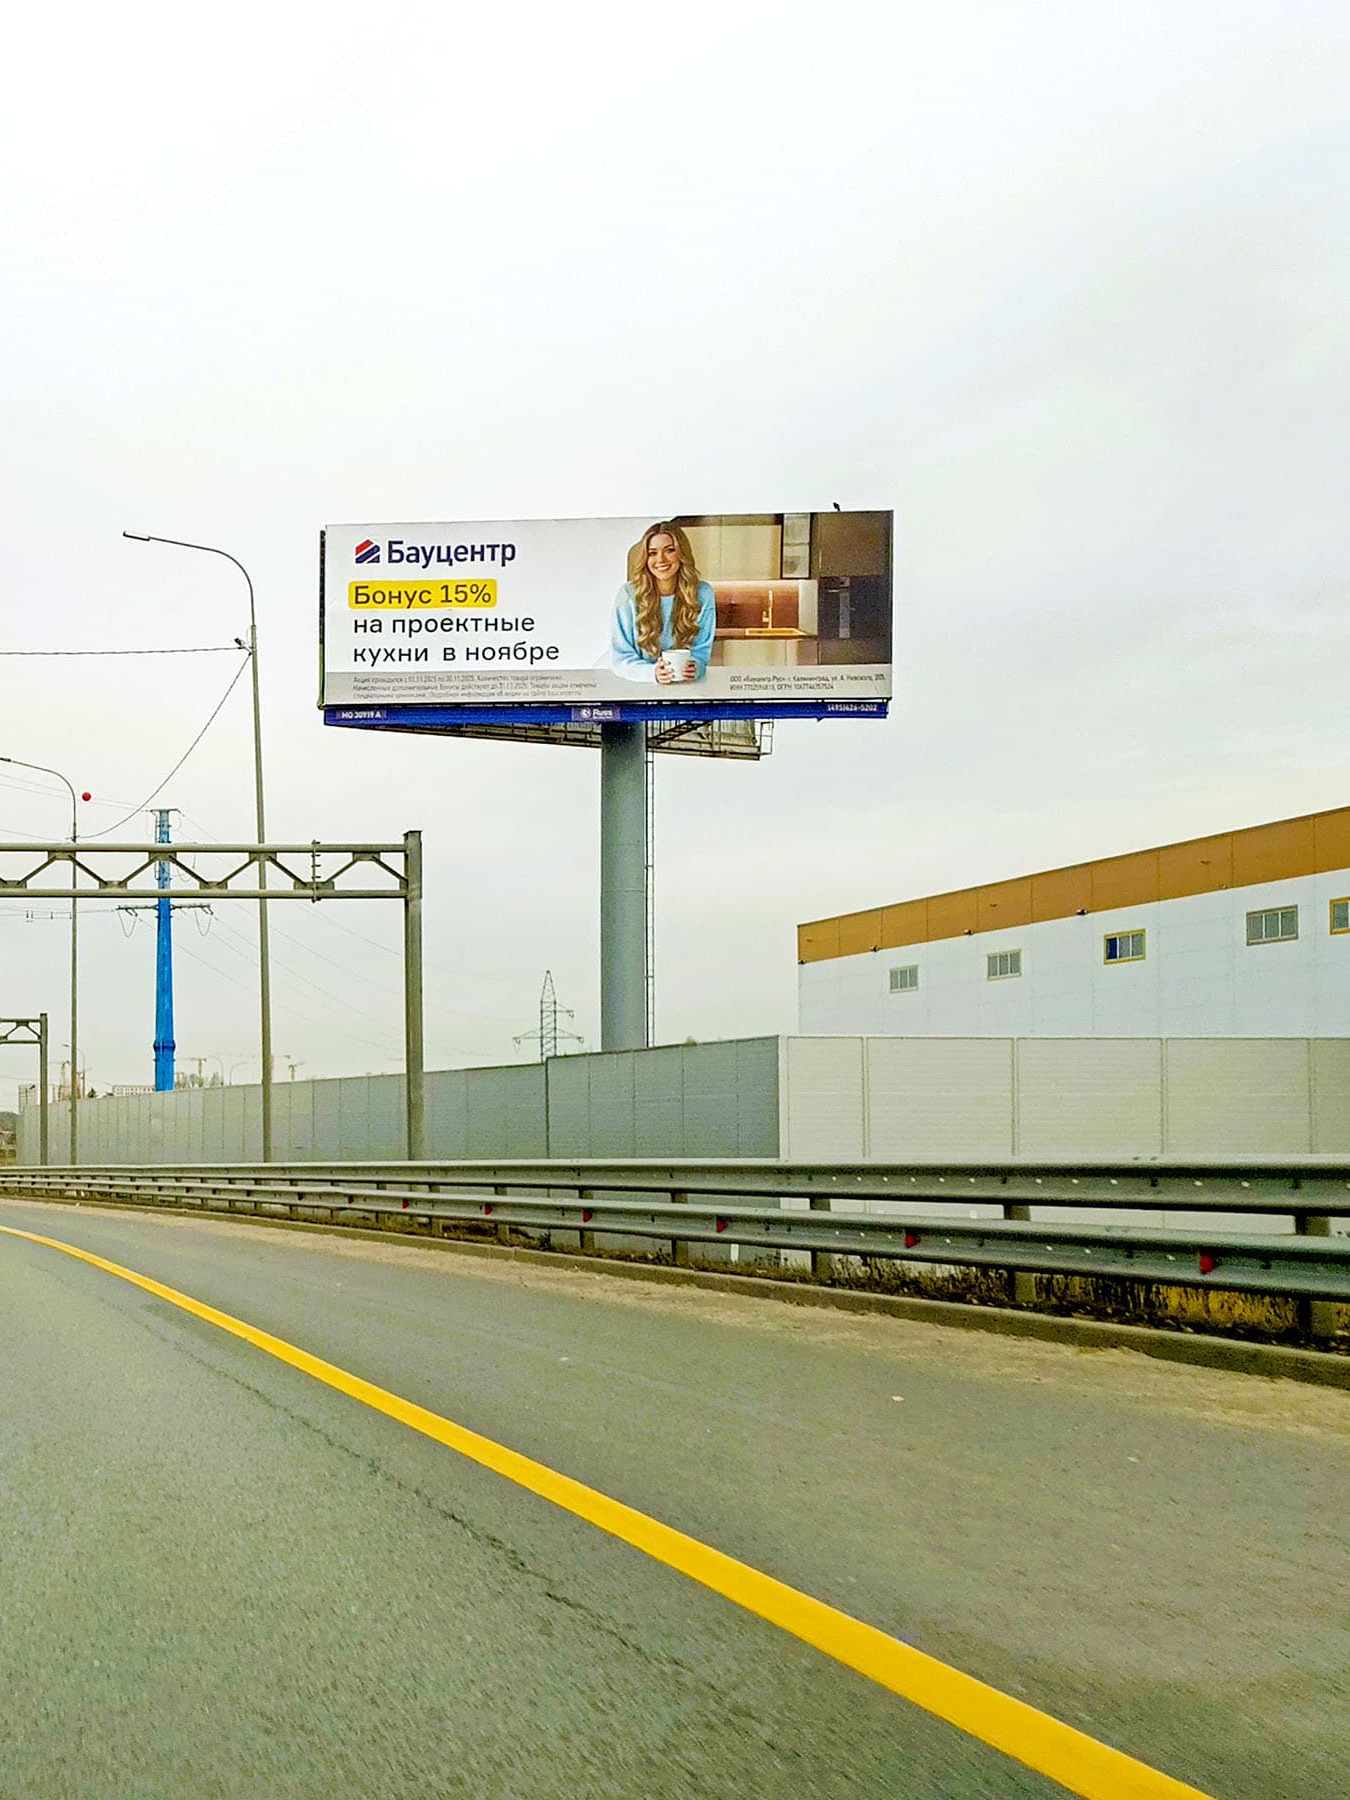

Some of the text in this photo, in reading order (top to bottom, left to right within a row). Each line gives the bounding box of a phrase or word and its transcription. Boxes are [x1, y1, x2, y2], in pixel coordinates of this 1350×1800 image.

[387, 540, 516, 568] Бауцентр
[354, 583, 492, 609] Бонус 15%
[353, 616, 535, 638] на проектные
[353, 641, 559, 667] кухни в ноябре
